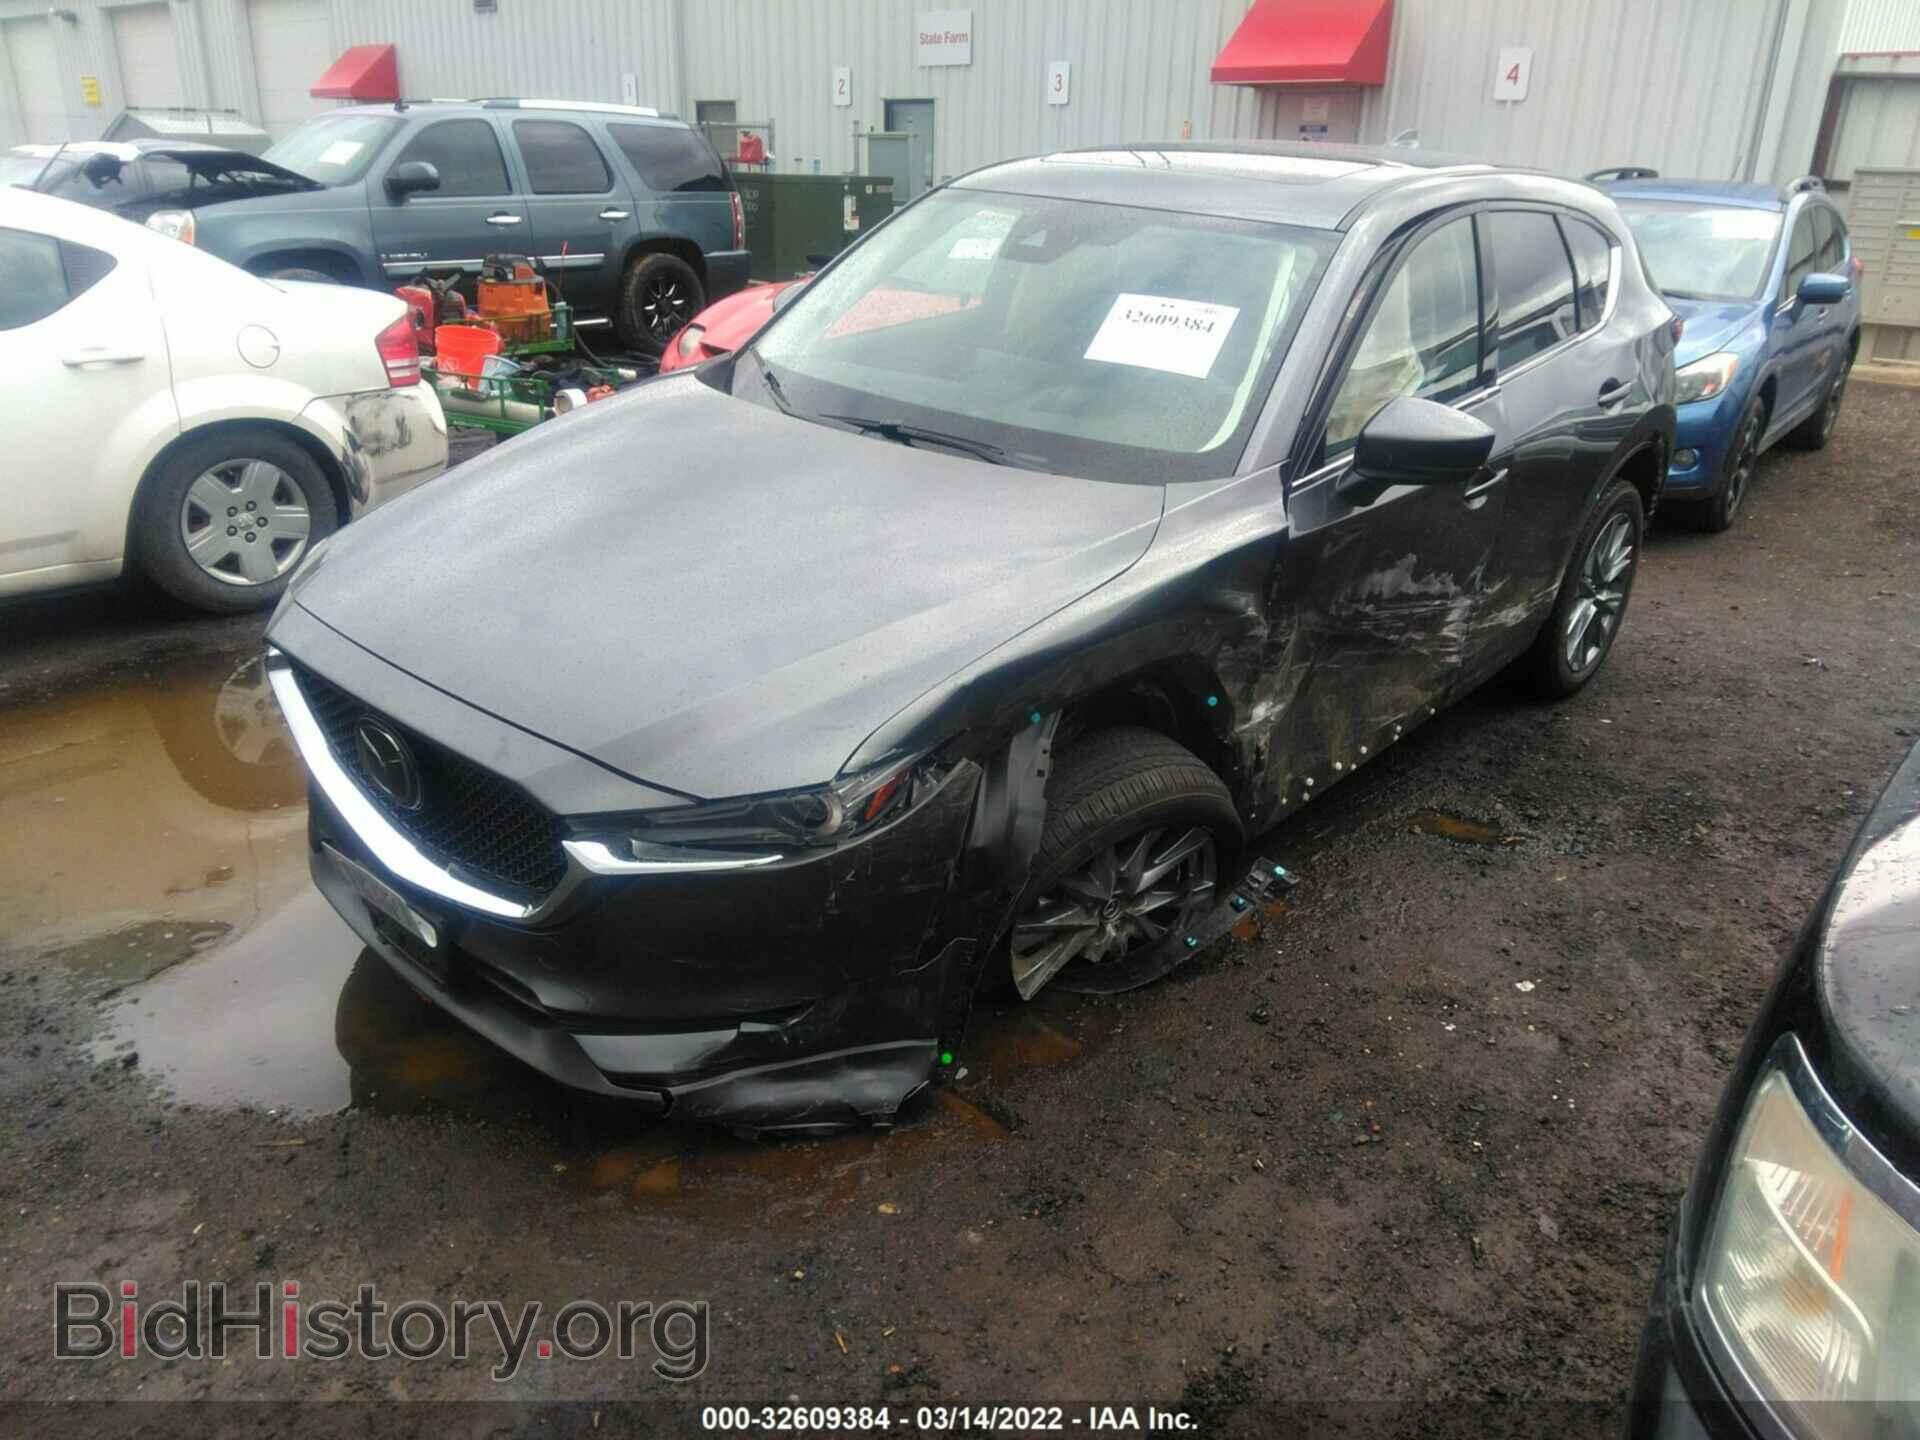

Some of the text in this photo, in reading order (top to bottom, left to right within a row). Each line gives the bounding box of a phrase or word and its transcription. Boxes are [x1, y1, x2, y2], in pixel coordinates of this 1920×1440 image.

[919, 29, 969, 46] State Farm
[1054, 73, 1063, 92] 3
[1506, 62, 1521, 85] 4
[837, 78, 846, 96] 2
[1121, 307, 1216, 334] 32609384
